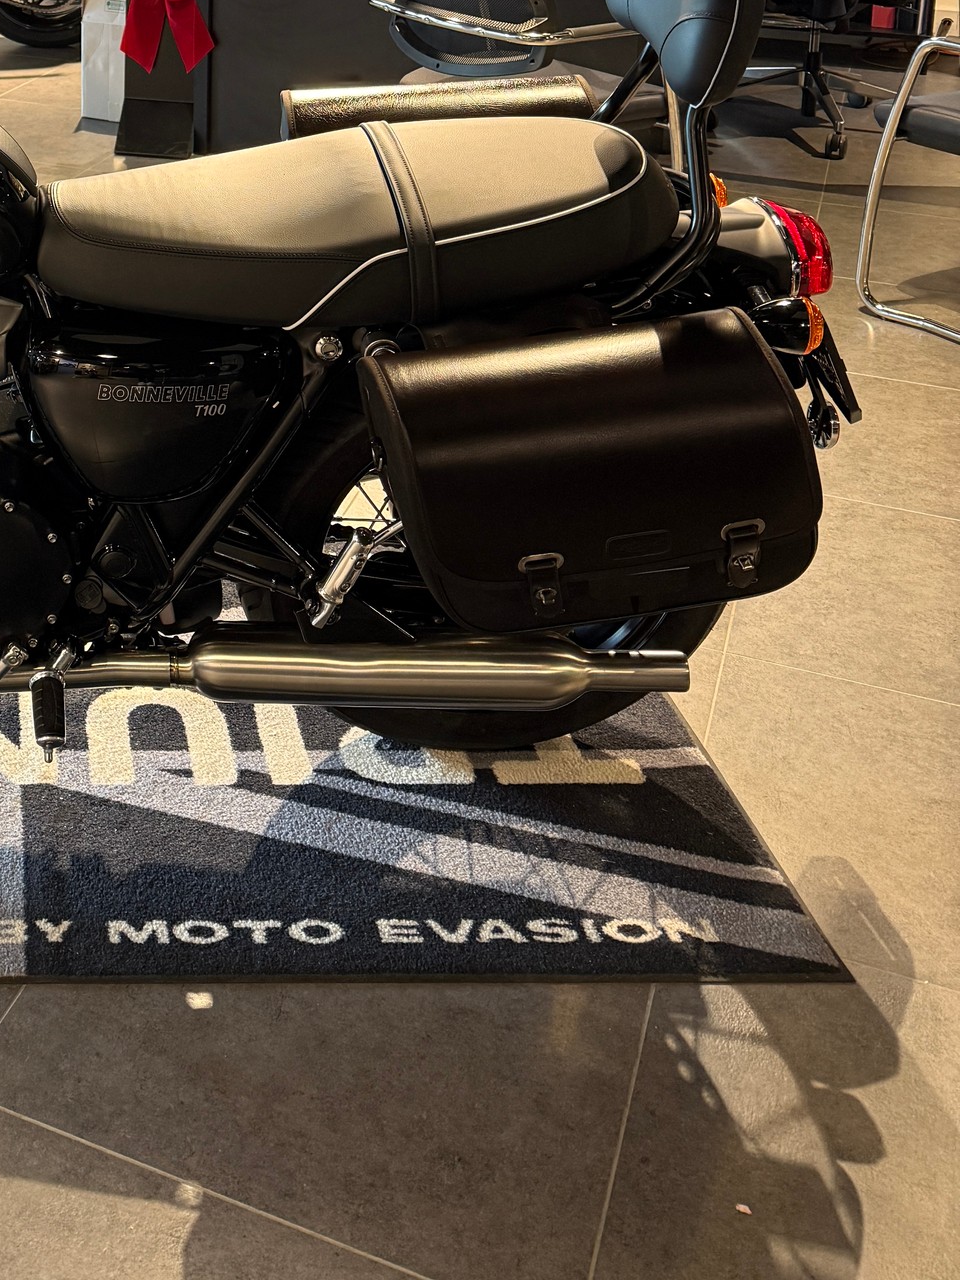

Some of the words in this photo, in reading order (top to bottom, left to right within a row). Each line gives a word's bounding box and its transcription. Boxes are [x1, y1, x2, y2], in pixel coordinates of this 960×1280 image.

[97, 383, 230, 403] BONNEVILLE
[195, 403, 227, 418] T100
[106, 918, 344, 945] MOTO
[379, 918, 719, 945] EVASION
